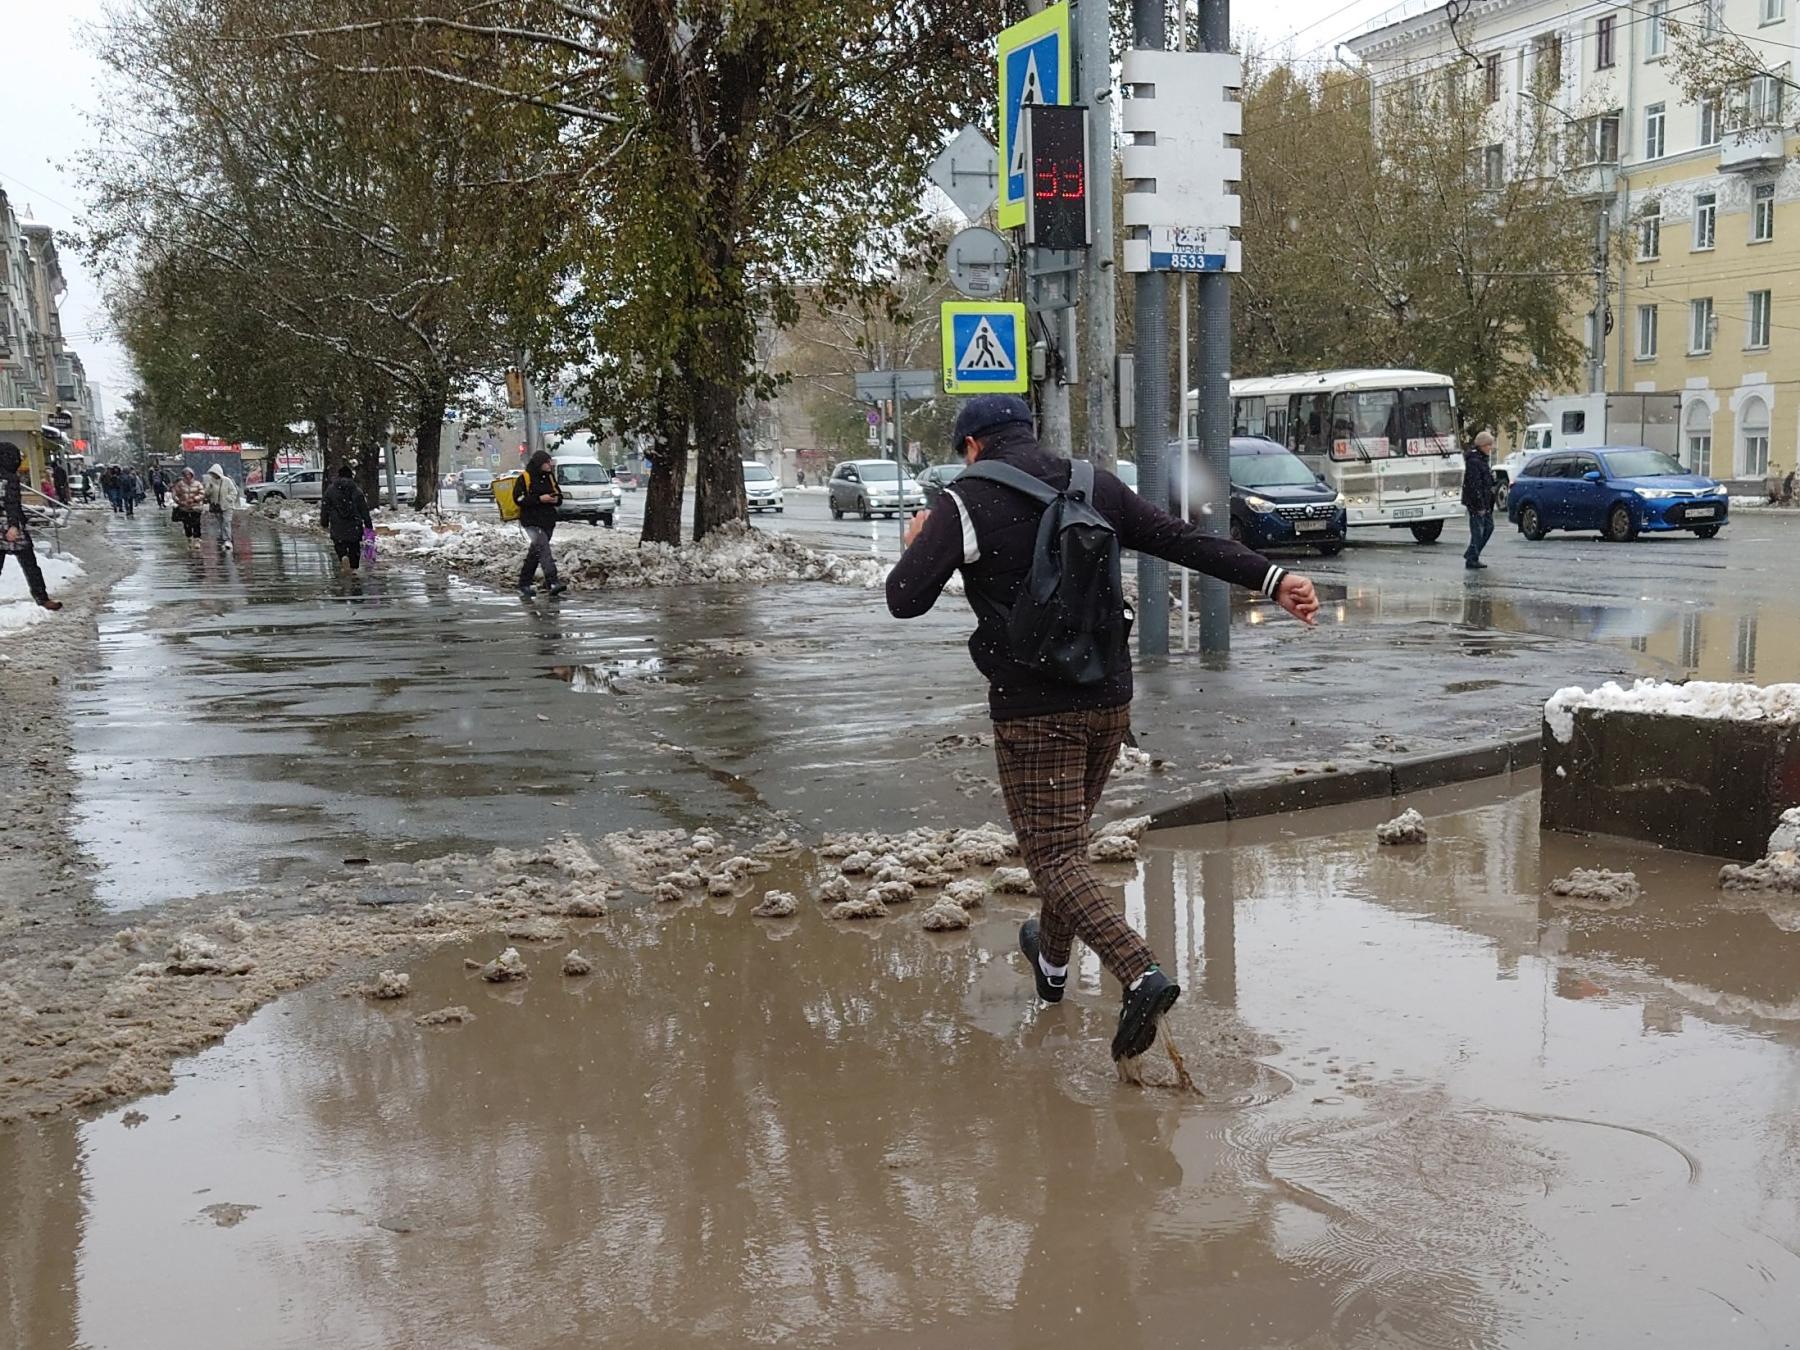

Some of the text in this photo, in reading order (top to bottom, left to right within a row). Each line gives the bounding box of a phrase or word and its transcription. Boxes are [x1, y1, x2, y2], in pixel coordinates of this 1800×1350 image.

[1171, 254, 1204, 268] 8533
[1335, 441, 1346, 455] 43
[1408, 439, 1419, 454] 43
